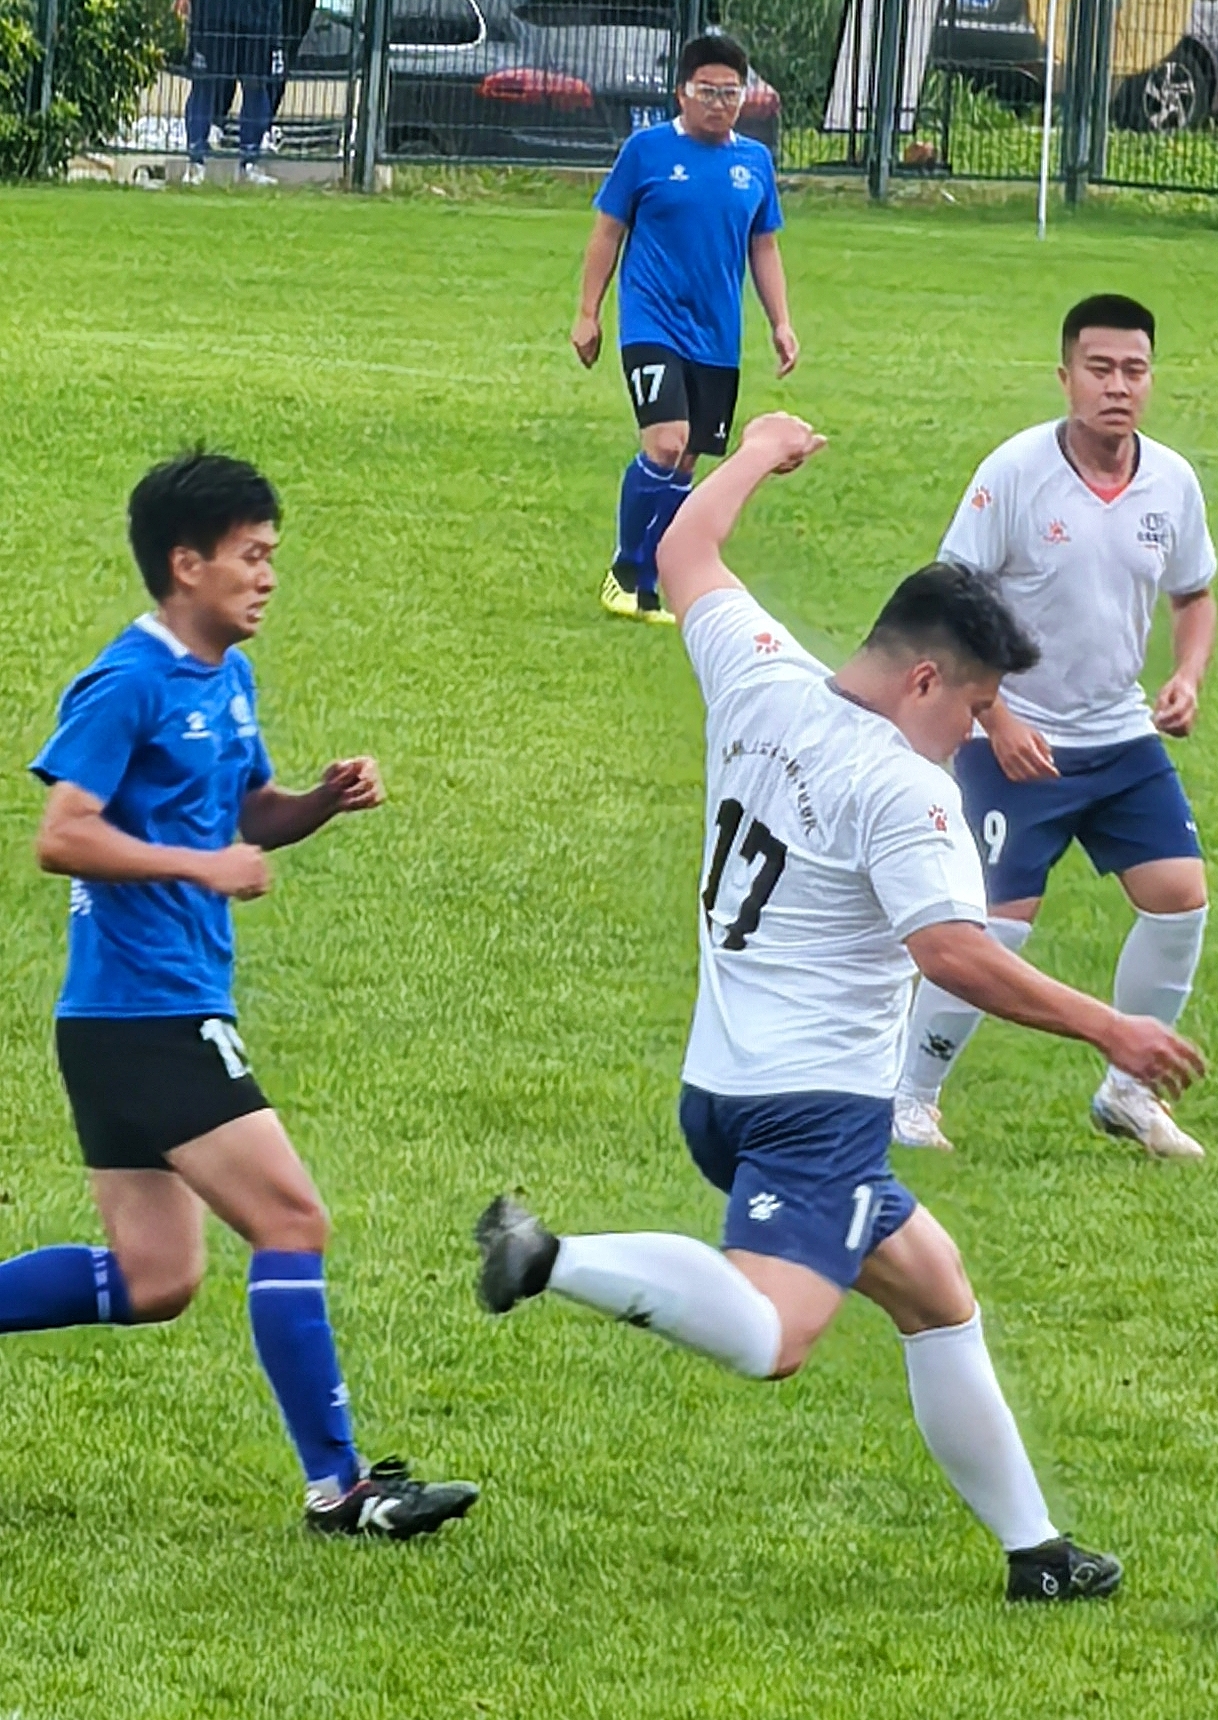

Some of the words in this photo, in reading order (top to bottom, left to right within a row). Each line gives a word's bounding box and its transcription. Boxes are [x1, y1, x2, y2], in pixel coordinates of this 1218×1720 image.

[631, 364, 666, 406] 17
[983, 810, 1007, 865] 9
[701, 798, 788, 951] 17
